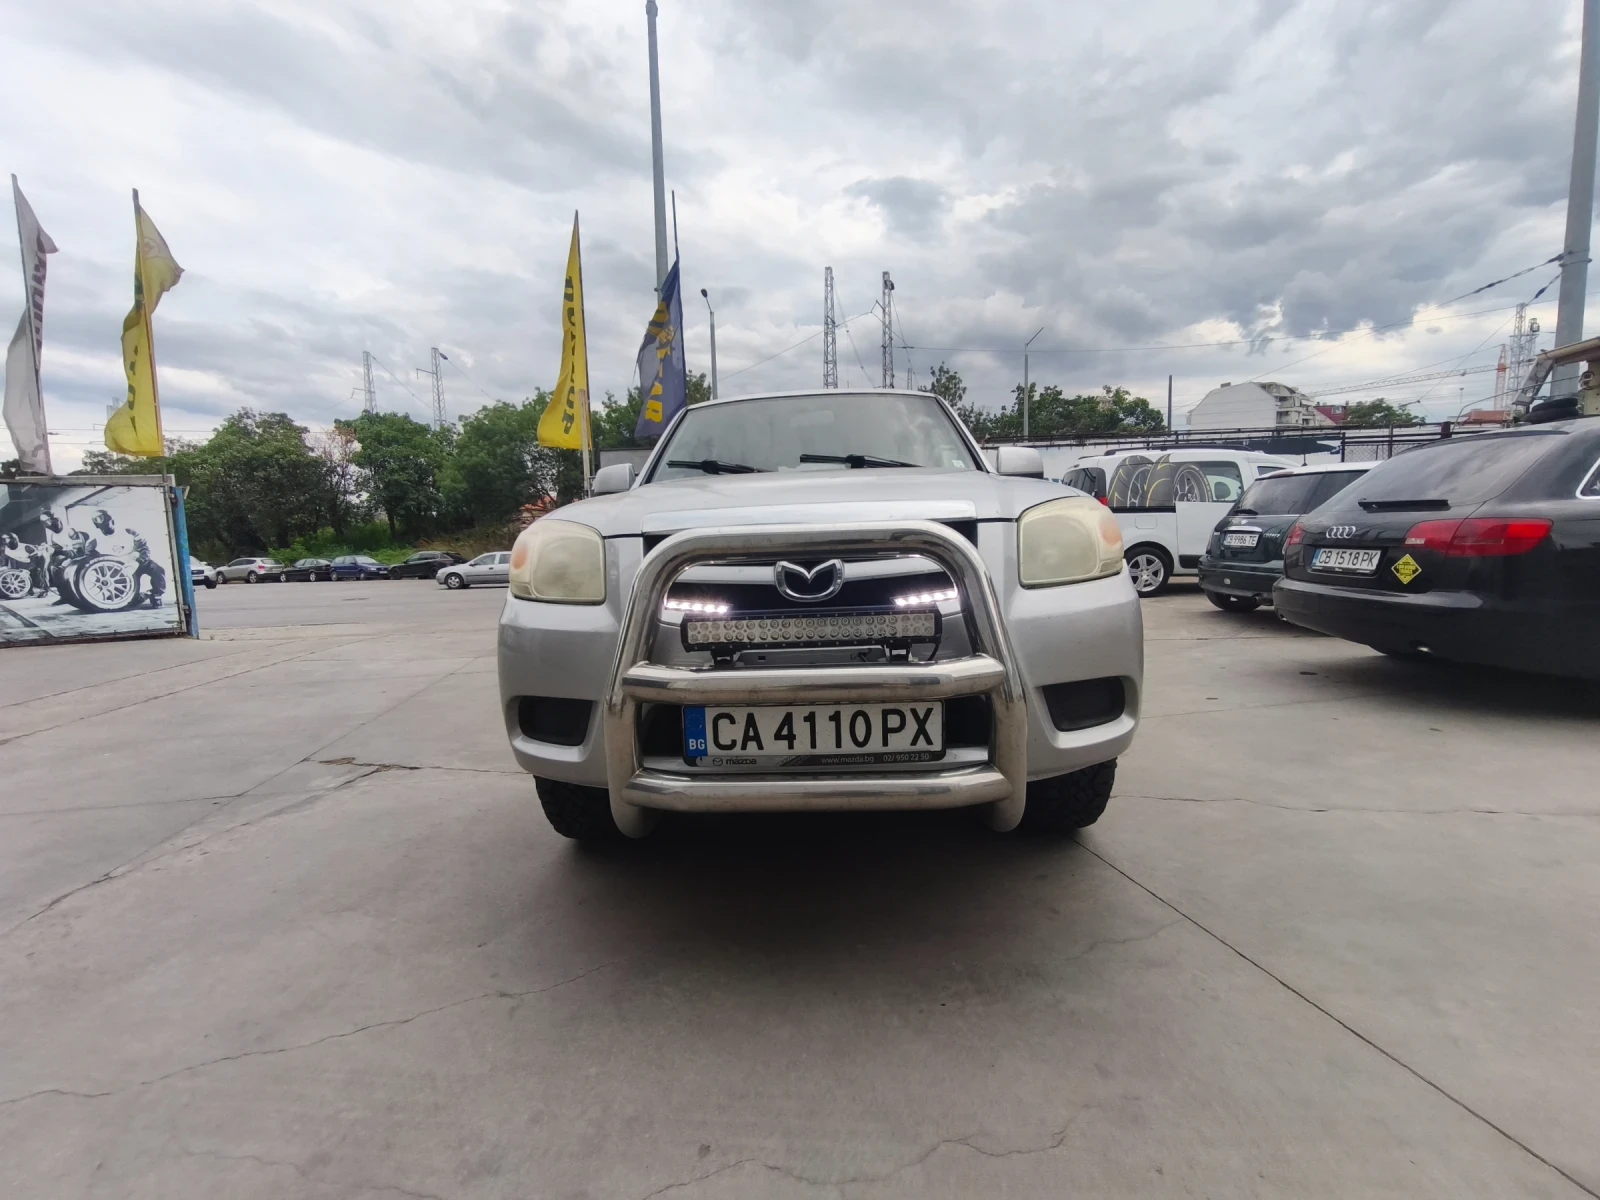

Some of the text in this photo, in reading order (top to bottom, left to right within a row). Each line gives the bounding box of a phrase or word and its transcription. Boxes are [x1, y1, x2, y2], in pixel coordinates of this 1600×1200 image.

[1319, 550, 1378, 567] CB 1518 PK
[712, 707, 934, 751] CA 4110 PX
[688, 739, 705, 750] BG
[821, 755, 874, 764] www.mazda.bg
